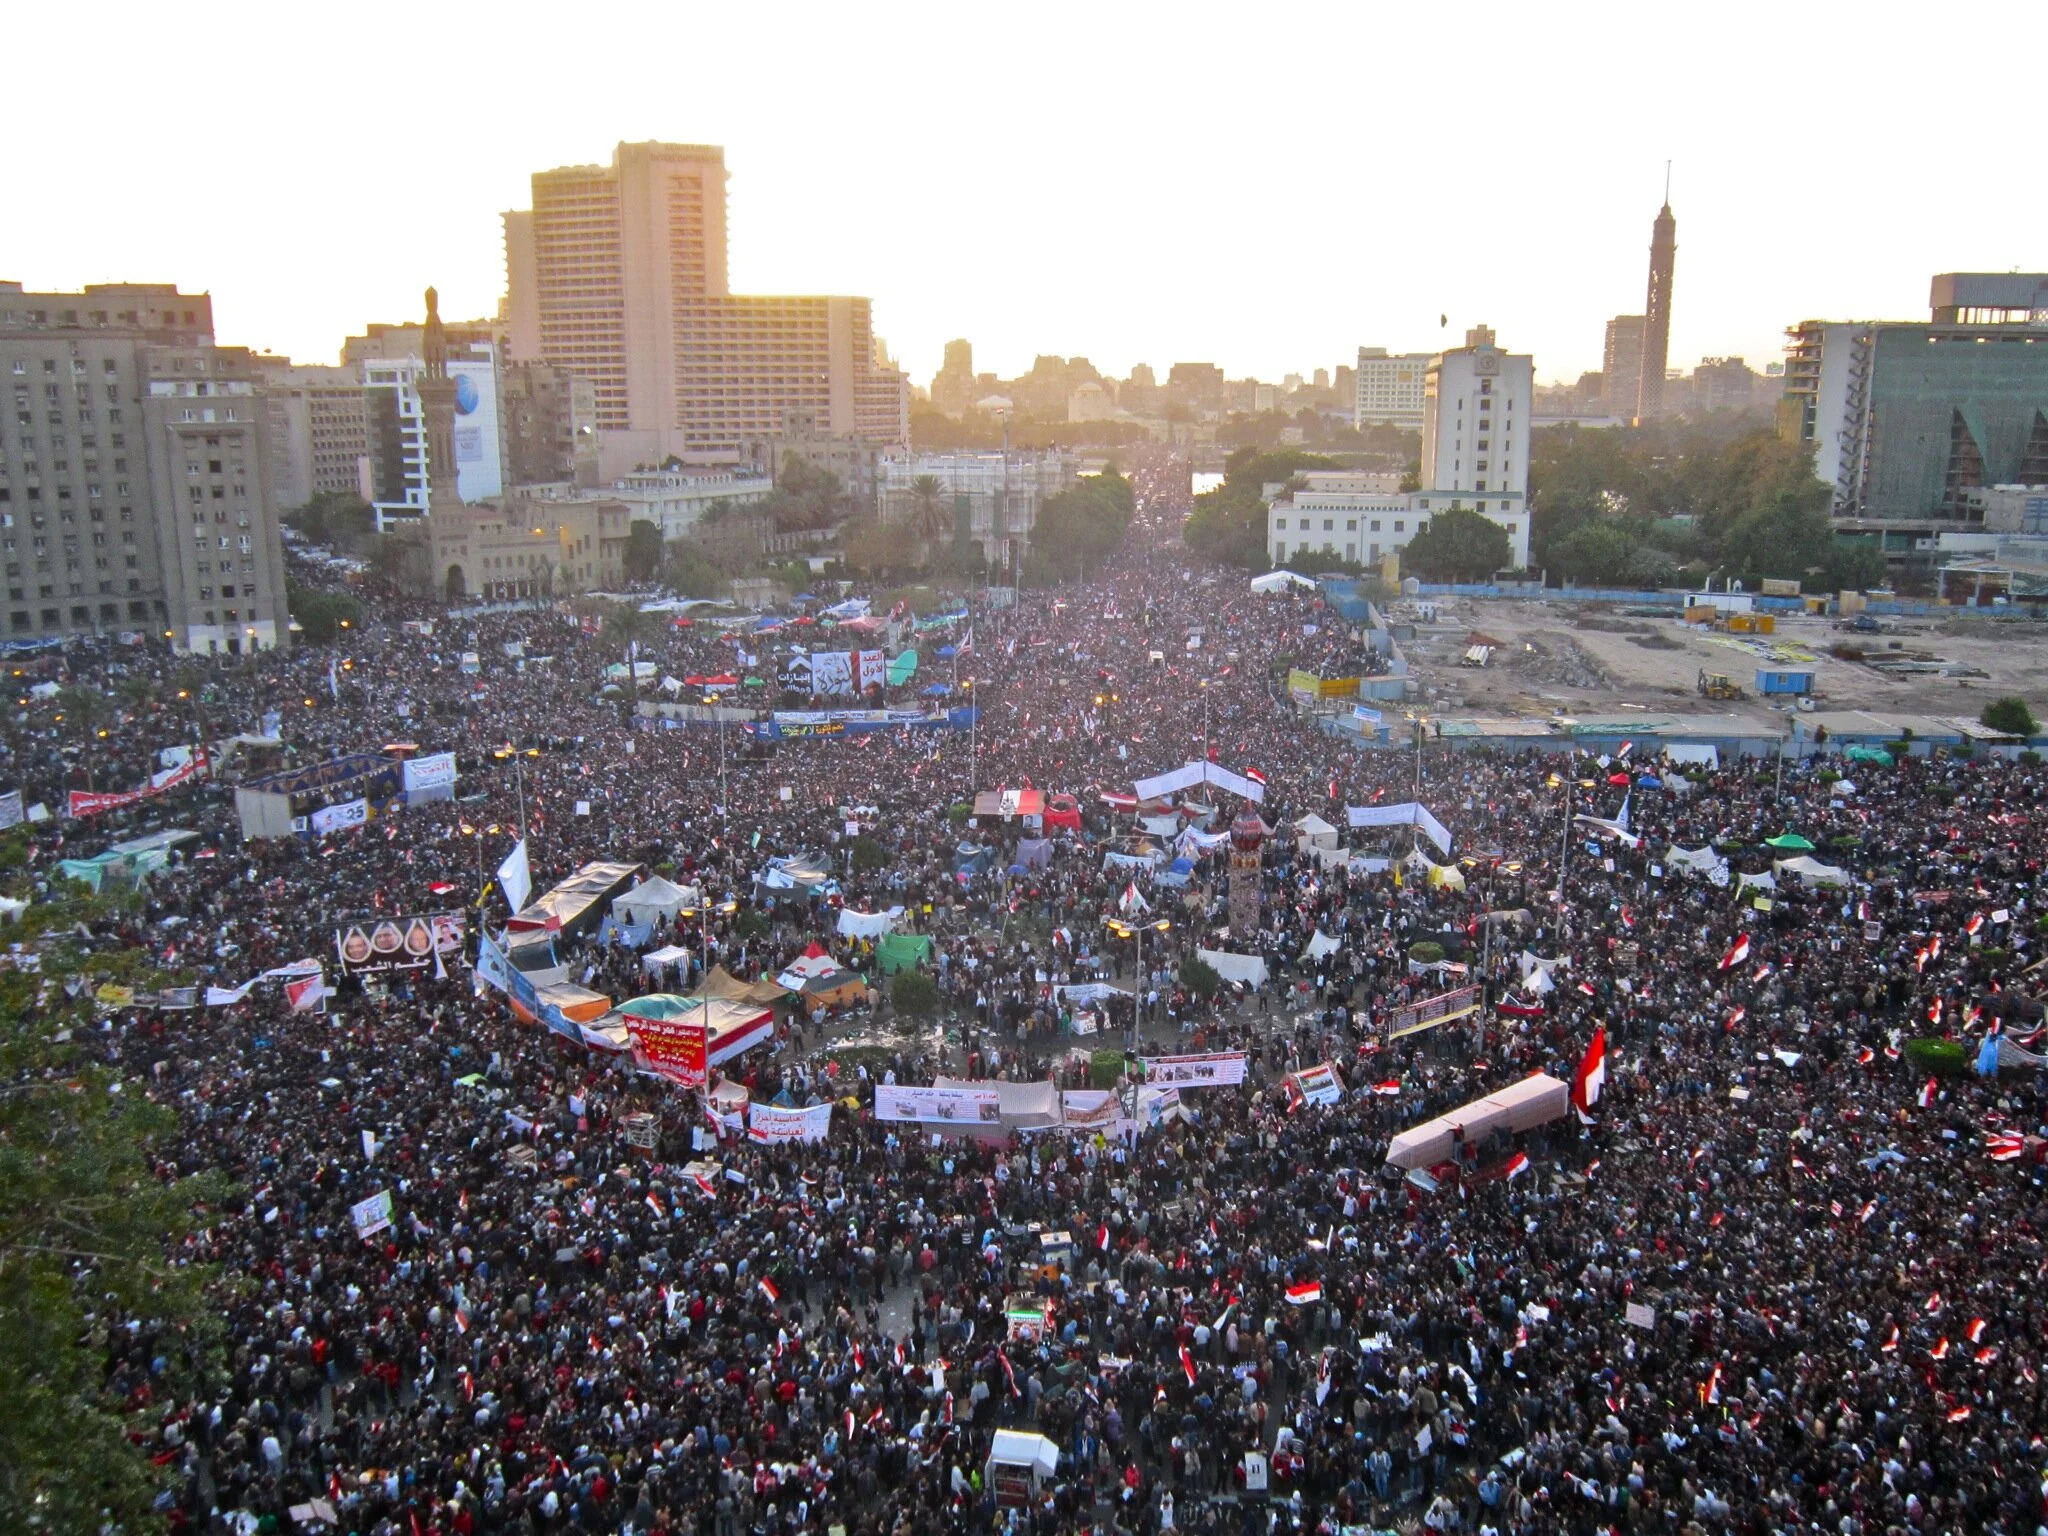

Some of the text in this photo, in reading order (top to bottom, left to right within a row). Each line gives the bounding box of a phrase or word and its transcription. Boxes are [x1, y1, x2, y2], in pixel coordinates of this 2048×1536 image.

[346, 805, 364, 820] 25
[351, 957, 431, 976] حكم الشعب
[774, 1114, 806, 1124] العباسية
